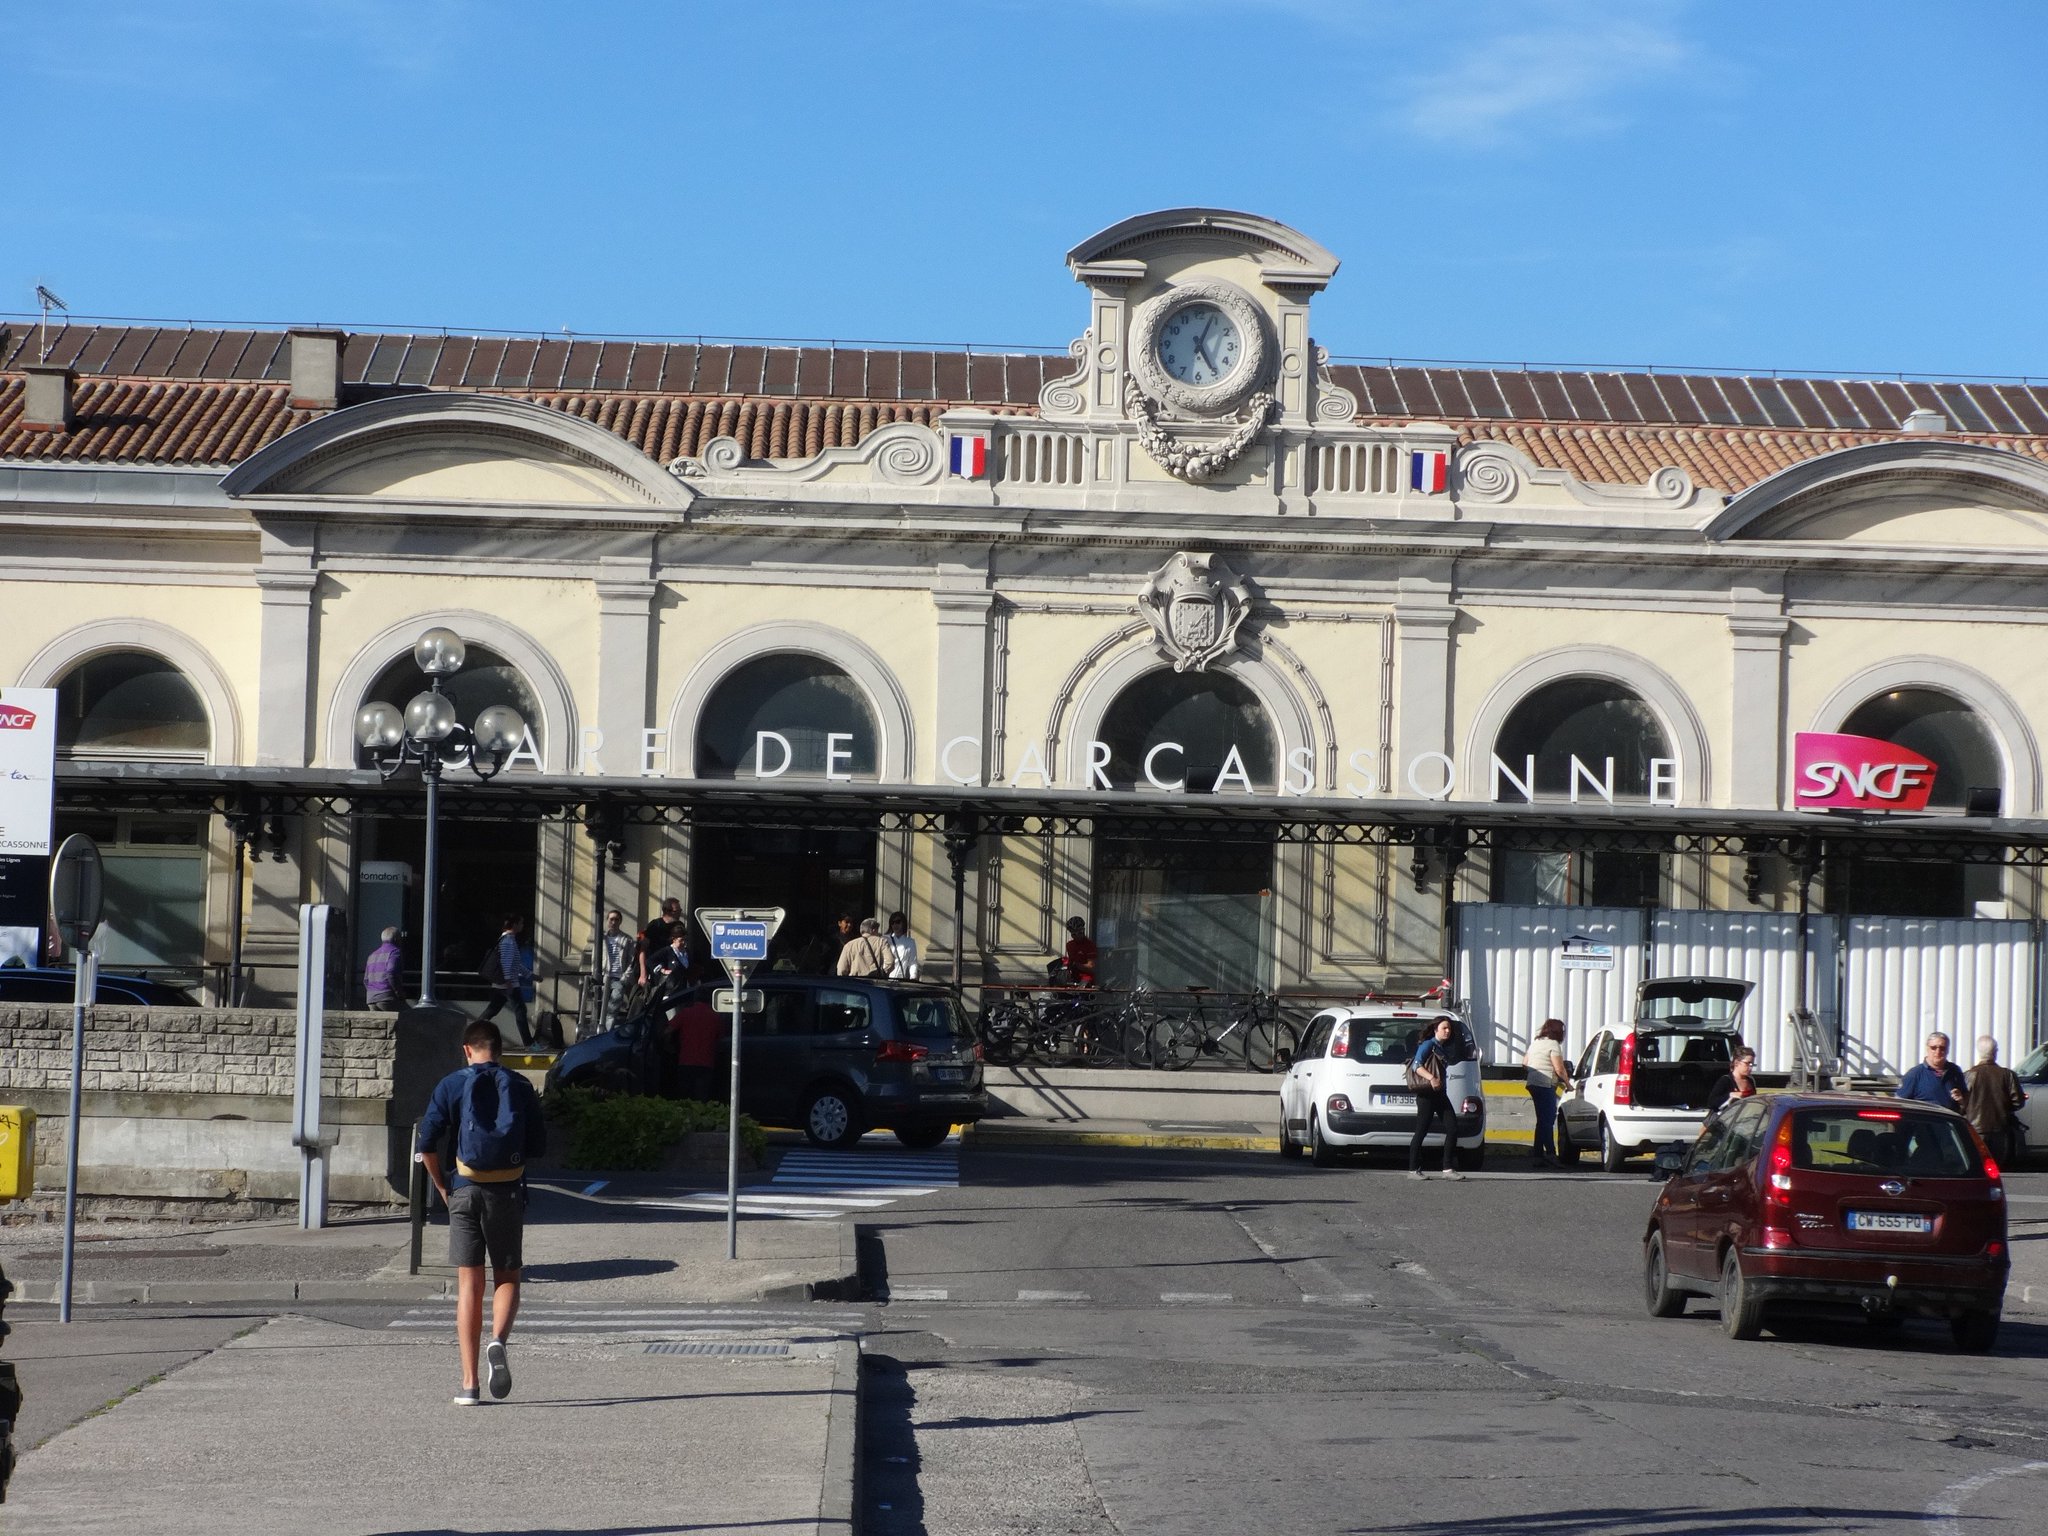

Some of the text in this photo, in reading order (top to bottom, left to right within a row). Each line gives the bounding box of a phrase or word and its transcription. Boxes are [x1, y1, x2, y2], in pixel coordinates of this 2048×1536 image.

[1182, 316, 1189, 324] 11
[1169, 326, 1180, 335] 10
[1223, 328, 1230, 336] 2
[1164, 340, 1171, 349] 9
[1227, 342, 1234, 351] 3
[1168, 355, 1175, 364] 8
[1222, 356, 1229, 365] 4
[1180, 367, 1186, 375] 7
[1211, 368, 1218, 376] 5
[1195, 372, 1202, 380] 6
[0, 714, 33, 726] NCF
[756, 730, 854, 780] DE
[941, 735, 1677, 807] CARCASSONNE
[1799, 762, 1928, 798] SNCF
[0, 840, 48, 849] CASSONNE
[727, 929, 765, 937] PROMENADE
[720, 942, 758, 950] du CANAL
